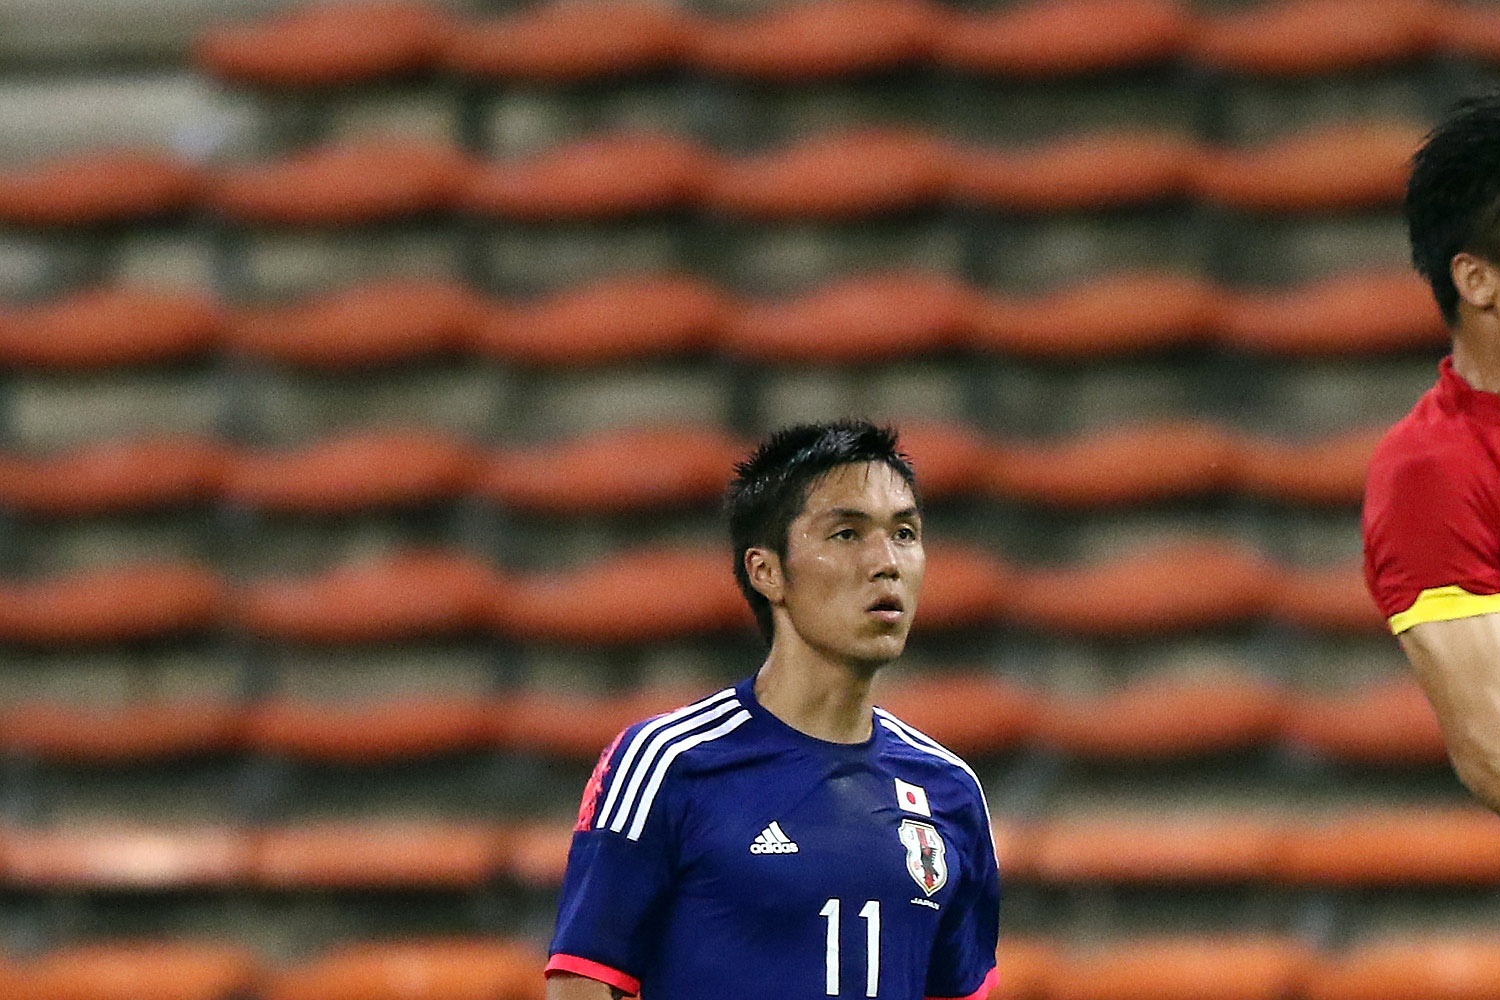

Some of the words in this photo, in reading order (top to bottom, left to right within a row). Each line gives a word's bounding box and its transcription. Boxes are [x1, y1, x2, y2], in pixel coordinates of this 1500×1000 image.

[750, 840, 799, 855] adidas
[910, 897, 941, 911] JAPAN
[819, 898, 880, 998] 11
